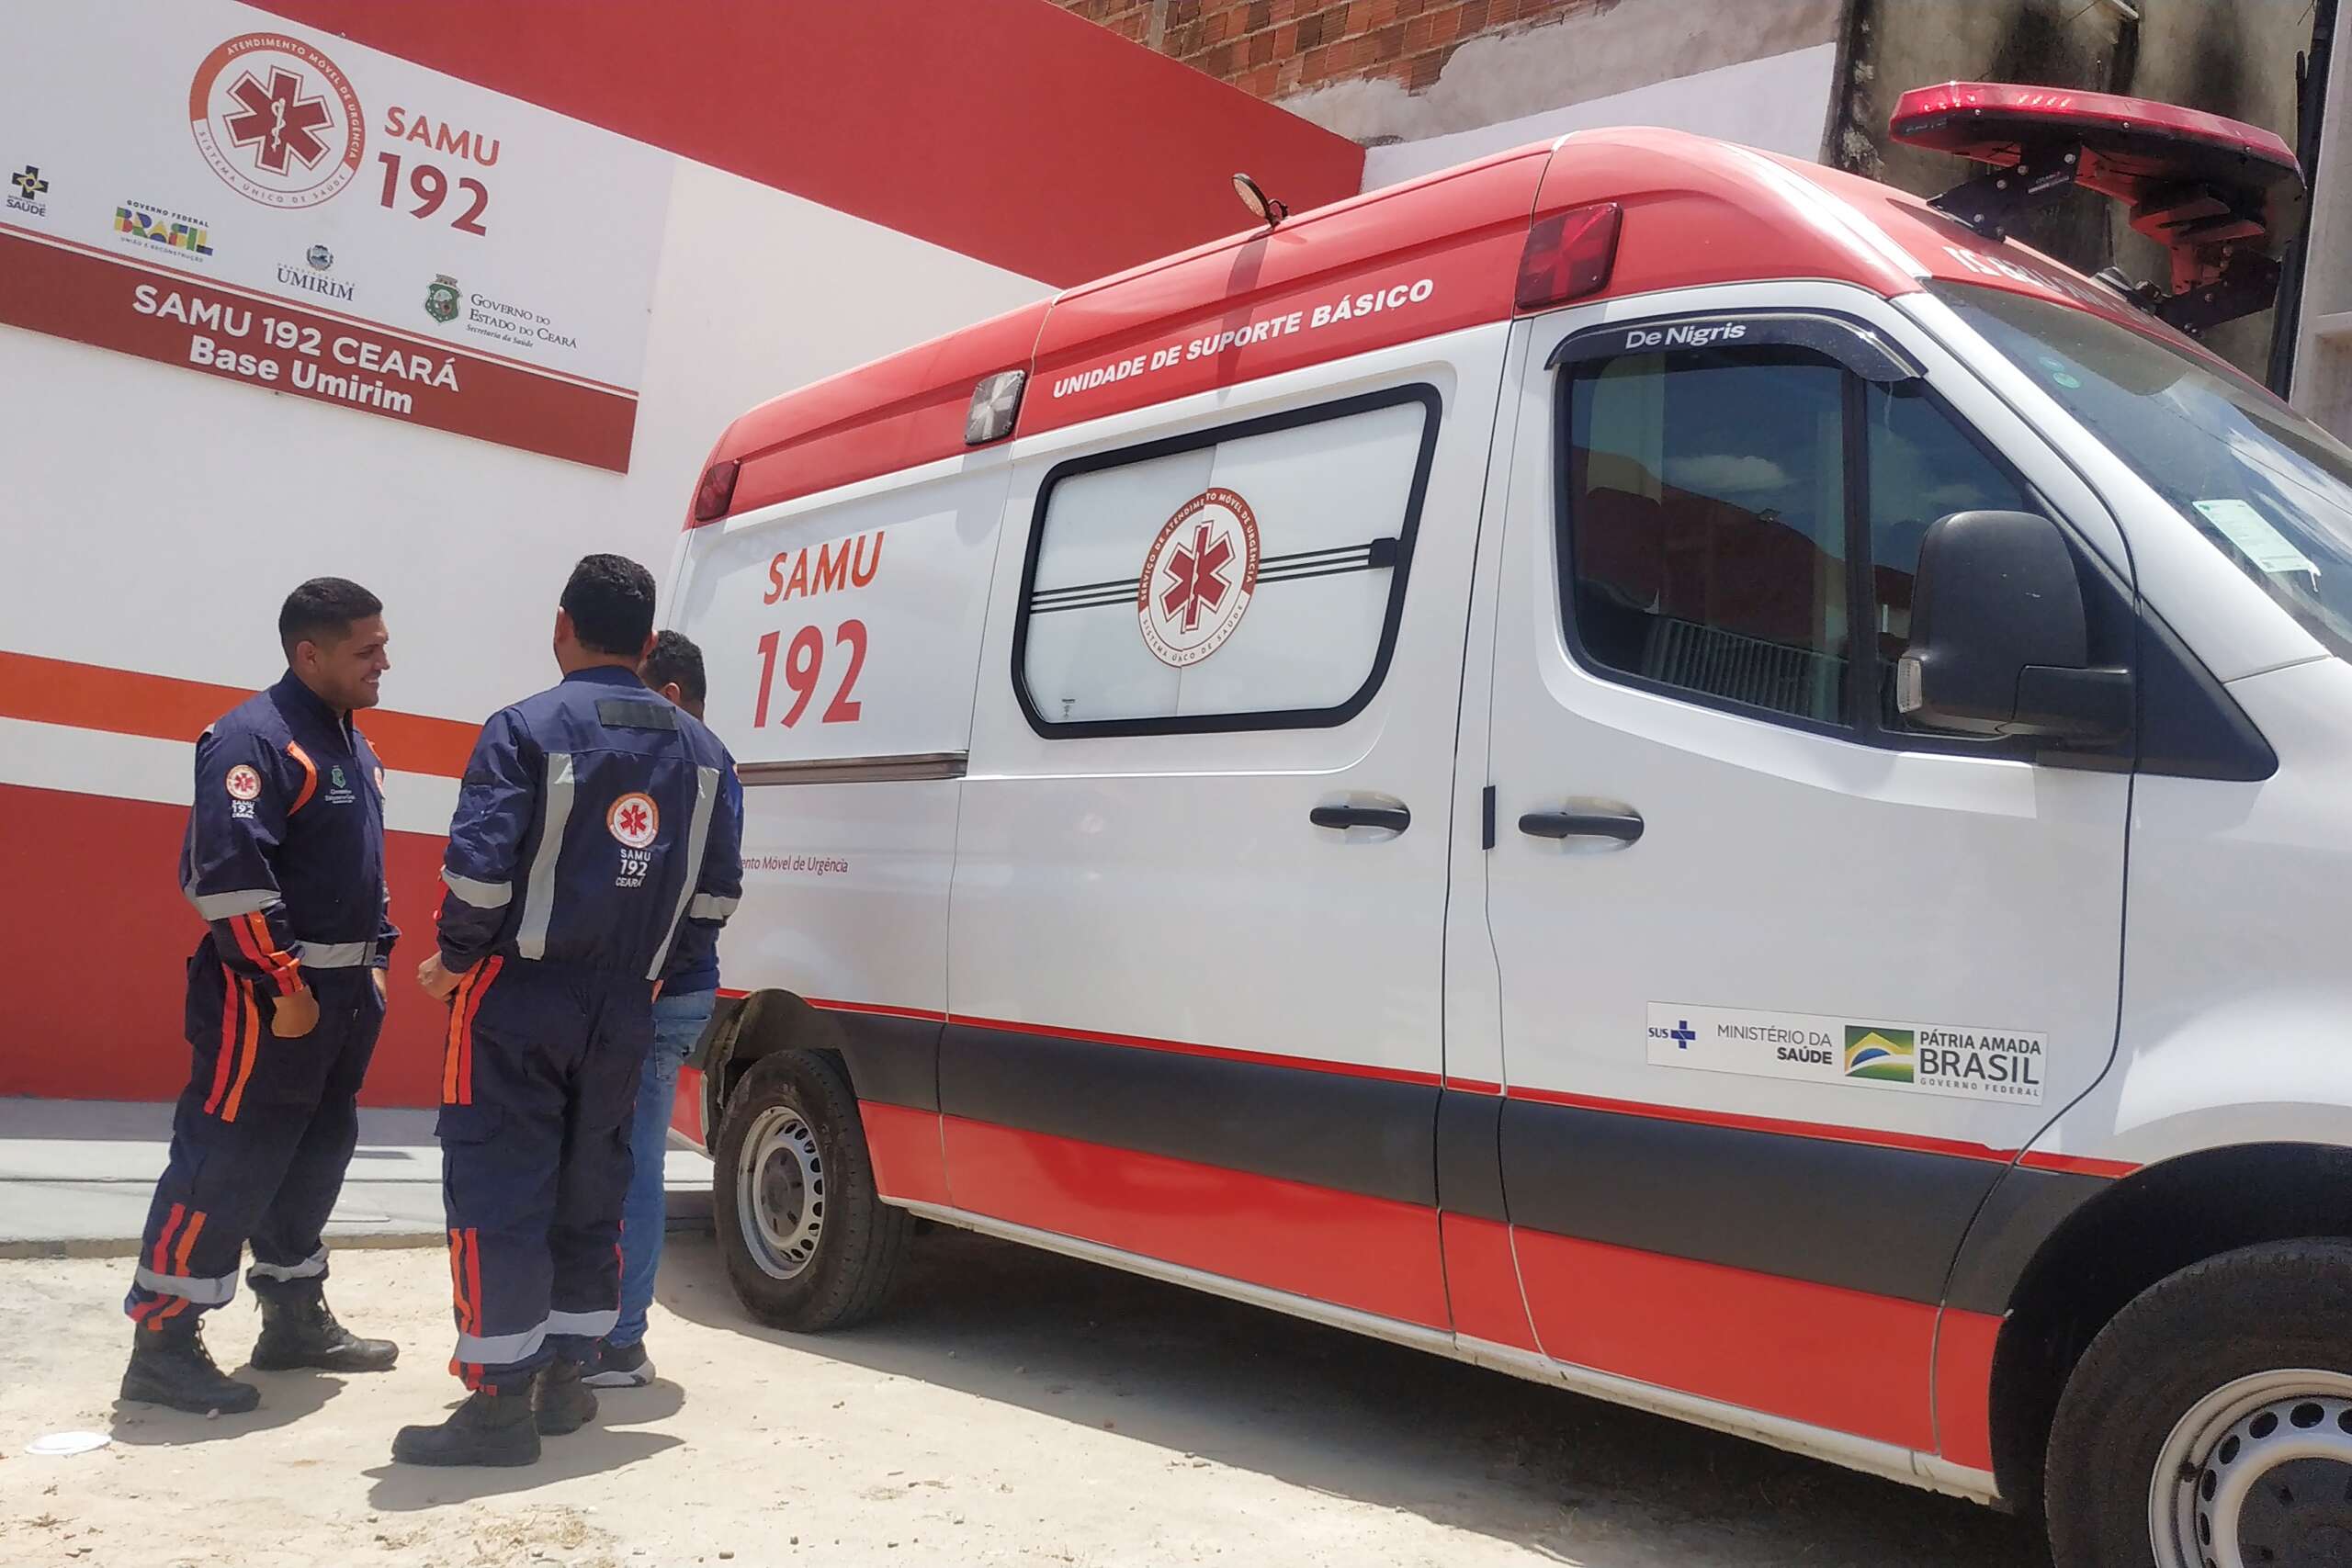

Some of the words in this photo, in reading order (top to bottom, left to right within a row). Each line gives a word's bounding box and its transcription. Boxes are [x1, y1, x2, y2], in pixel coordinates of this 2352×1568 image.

[227, 39, 305, 55] ATENDIMENTO
[309, 52, 341, 85] MÓVEL
[341, 85, 353, 101] DE
[384, 107, 500, 166] SAMU
[199, 131, 235, 183] SISTEMA
[293, 196, 307, 204] DE
[127, 199, 168, 216] GOVERNO
[172, 212, 209, 228] FEDERAL
[378, 152, 489, 237] 192
[114, 207, 213, 256] BRASIL
[277, 267, 354, 301] UMIRIM
[470, 293, 533, 321] GOVERNO
[132, 285, 252, 337] SAMU
[263, 318, 322, 355] 192
[333, 336, 459, 392] CEARÁ
[469, 308, 516, 332] ESTADO
[537, 327, 578, 348] CEARÁ
[1053, 355, 1147, 399] UNIDADE
[1150, 345, 1182, 371] DE
[1188, 311, 1303, 361] SUPORTE
[1310, 278, 1434, 329] BÁSICO
[1625, 331, 1662, 349] De
[1665, 322, 1747, 346] Nigris
[189, 334, 279, 380] Base
[291, 360, 413, 414] Umirim
[1154, 536, 1165, 550] DE
[1218, 493, 1242, 513] MÓVEL
[1241, 511, 1250, 525] DE
[763, 531, 885, 604] SAMU
[1143, 619, 1167, 657] SISTEMA
[1201, 643, 1212, 653] DE
[753, 618, 867, 728] 192
[232, 804, 254, 815] 192
[620, 849, 650, 862] SAMU
[620, 859, 648, 876] 192
[763, 854, 791, 871] Móvel
[793, 855, 805, 871] de
[808, 856, 848, 875] Urgência
[1648, 1027, 1668, 1039] SUS
[1717, 1024, 1804, 1044] MINISTÉRIO
[1809, 1032, 1832, 1047] DA
[1920, 1029, 1975, 1050] PÁTRIA
[1979, 1036, 2041, 1055] AMADA
[1777, 1045, 1833, 1066] SAÚDE
[1920, 1047, 2040, 1085] BRASIL
[1920, 1077, 1978, 1090] GOVERNO
[1985, 1084, 2040, 1097] FEDERAL
